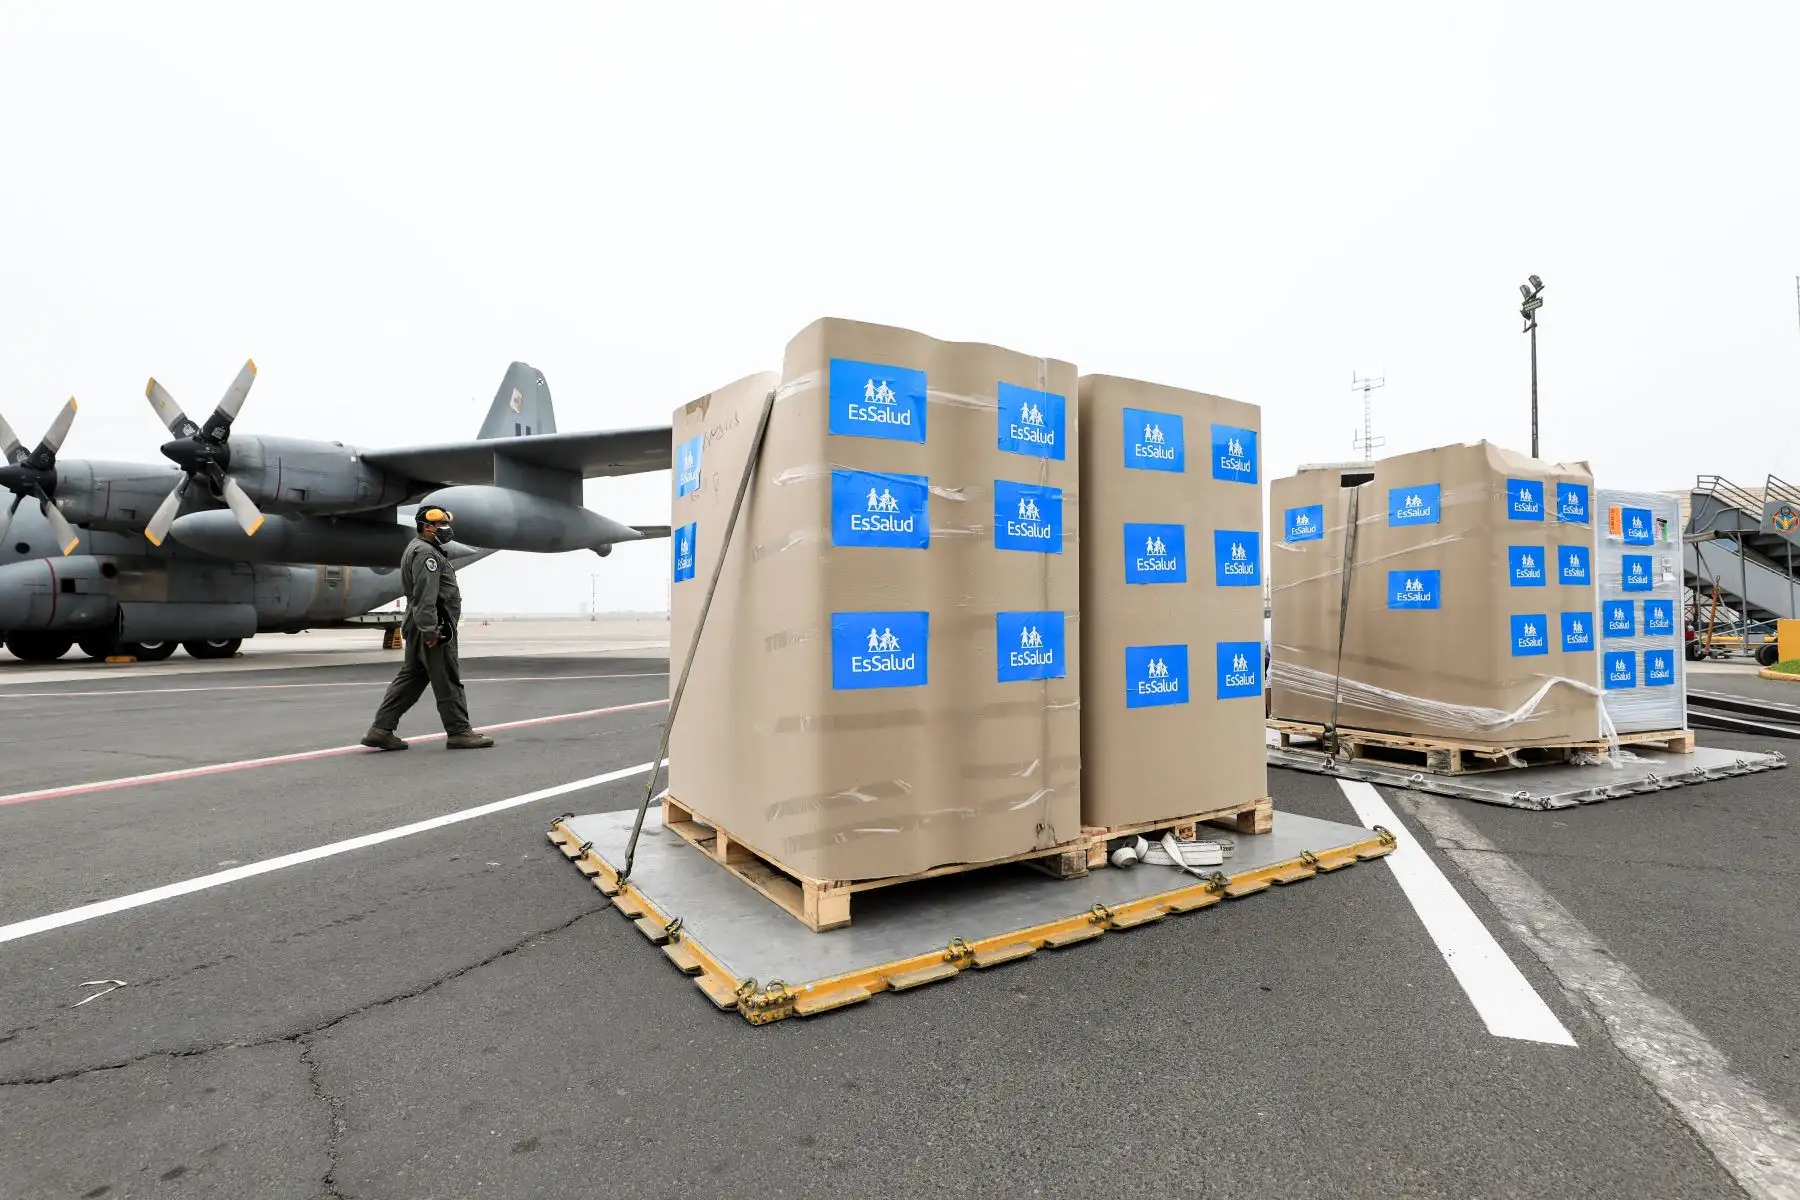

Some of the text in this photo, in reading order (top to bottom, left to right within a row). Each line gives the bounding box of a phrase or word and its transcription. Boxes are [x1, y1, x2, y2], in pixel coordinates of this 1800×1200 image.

[849, 403, 910, 425] EsSalud
[1011, 422, 1054, 444] EsSalud
[1136, 443, 1174, 459] EsSalud
[1221, 456, 1250, 472] EsSalud
[1398, 507, 1430, 518] EsSalud
[1515, 503, 1538, 512] EsSalud
[1563, 505, 1583, 516] EsSalud
[852, 515, 913, 532] EsSalud
[1008, 520, 1050, 538] EsSalud
[1292, 525, 1316, 535] EsSalud
[1628, 529, 1648, 538] EsSalud
[1137, 558, 1176, 571] EsSalud
[1225, 563, 1253, 574] EsSalud
[1516, 569, 1540, 578] EsSalud
[1564, 568, 1584, 577] EsSalud
[1628, 575, 1647, 584] EsSalud
[1397, 592, 1430, 601] EsSalud
[1610, 621, 1629, 629] EsSalud
[1519, 637, 1542, 647] EsSalud
[1567, 634, 1588, 643] EsSalud
[852, 654, 914, 672] EsSalud
[1011, 649, 1052, 666] EsSalud
[1226, 673, 1254, 686] EsSalud
[1611, 672, 1631, 681] EsSalud
[1651, 670, 1669, 678] EsSalud
[1139, 679, 1178, 694] EsSalud
